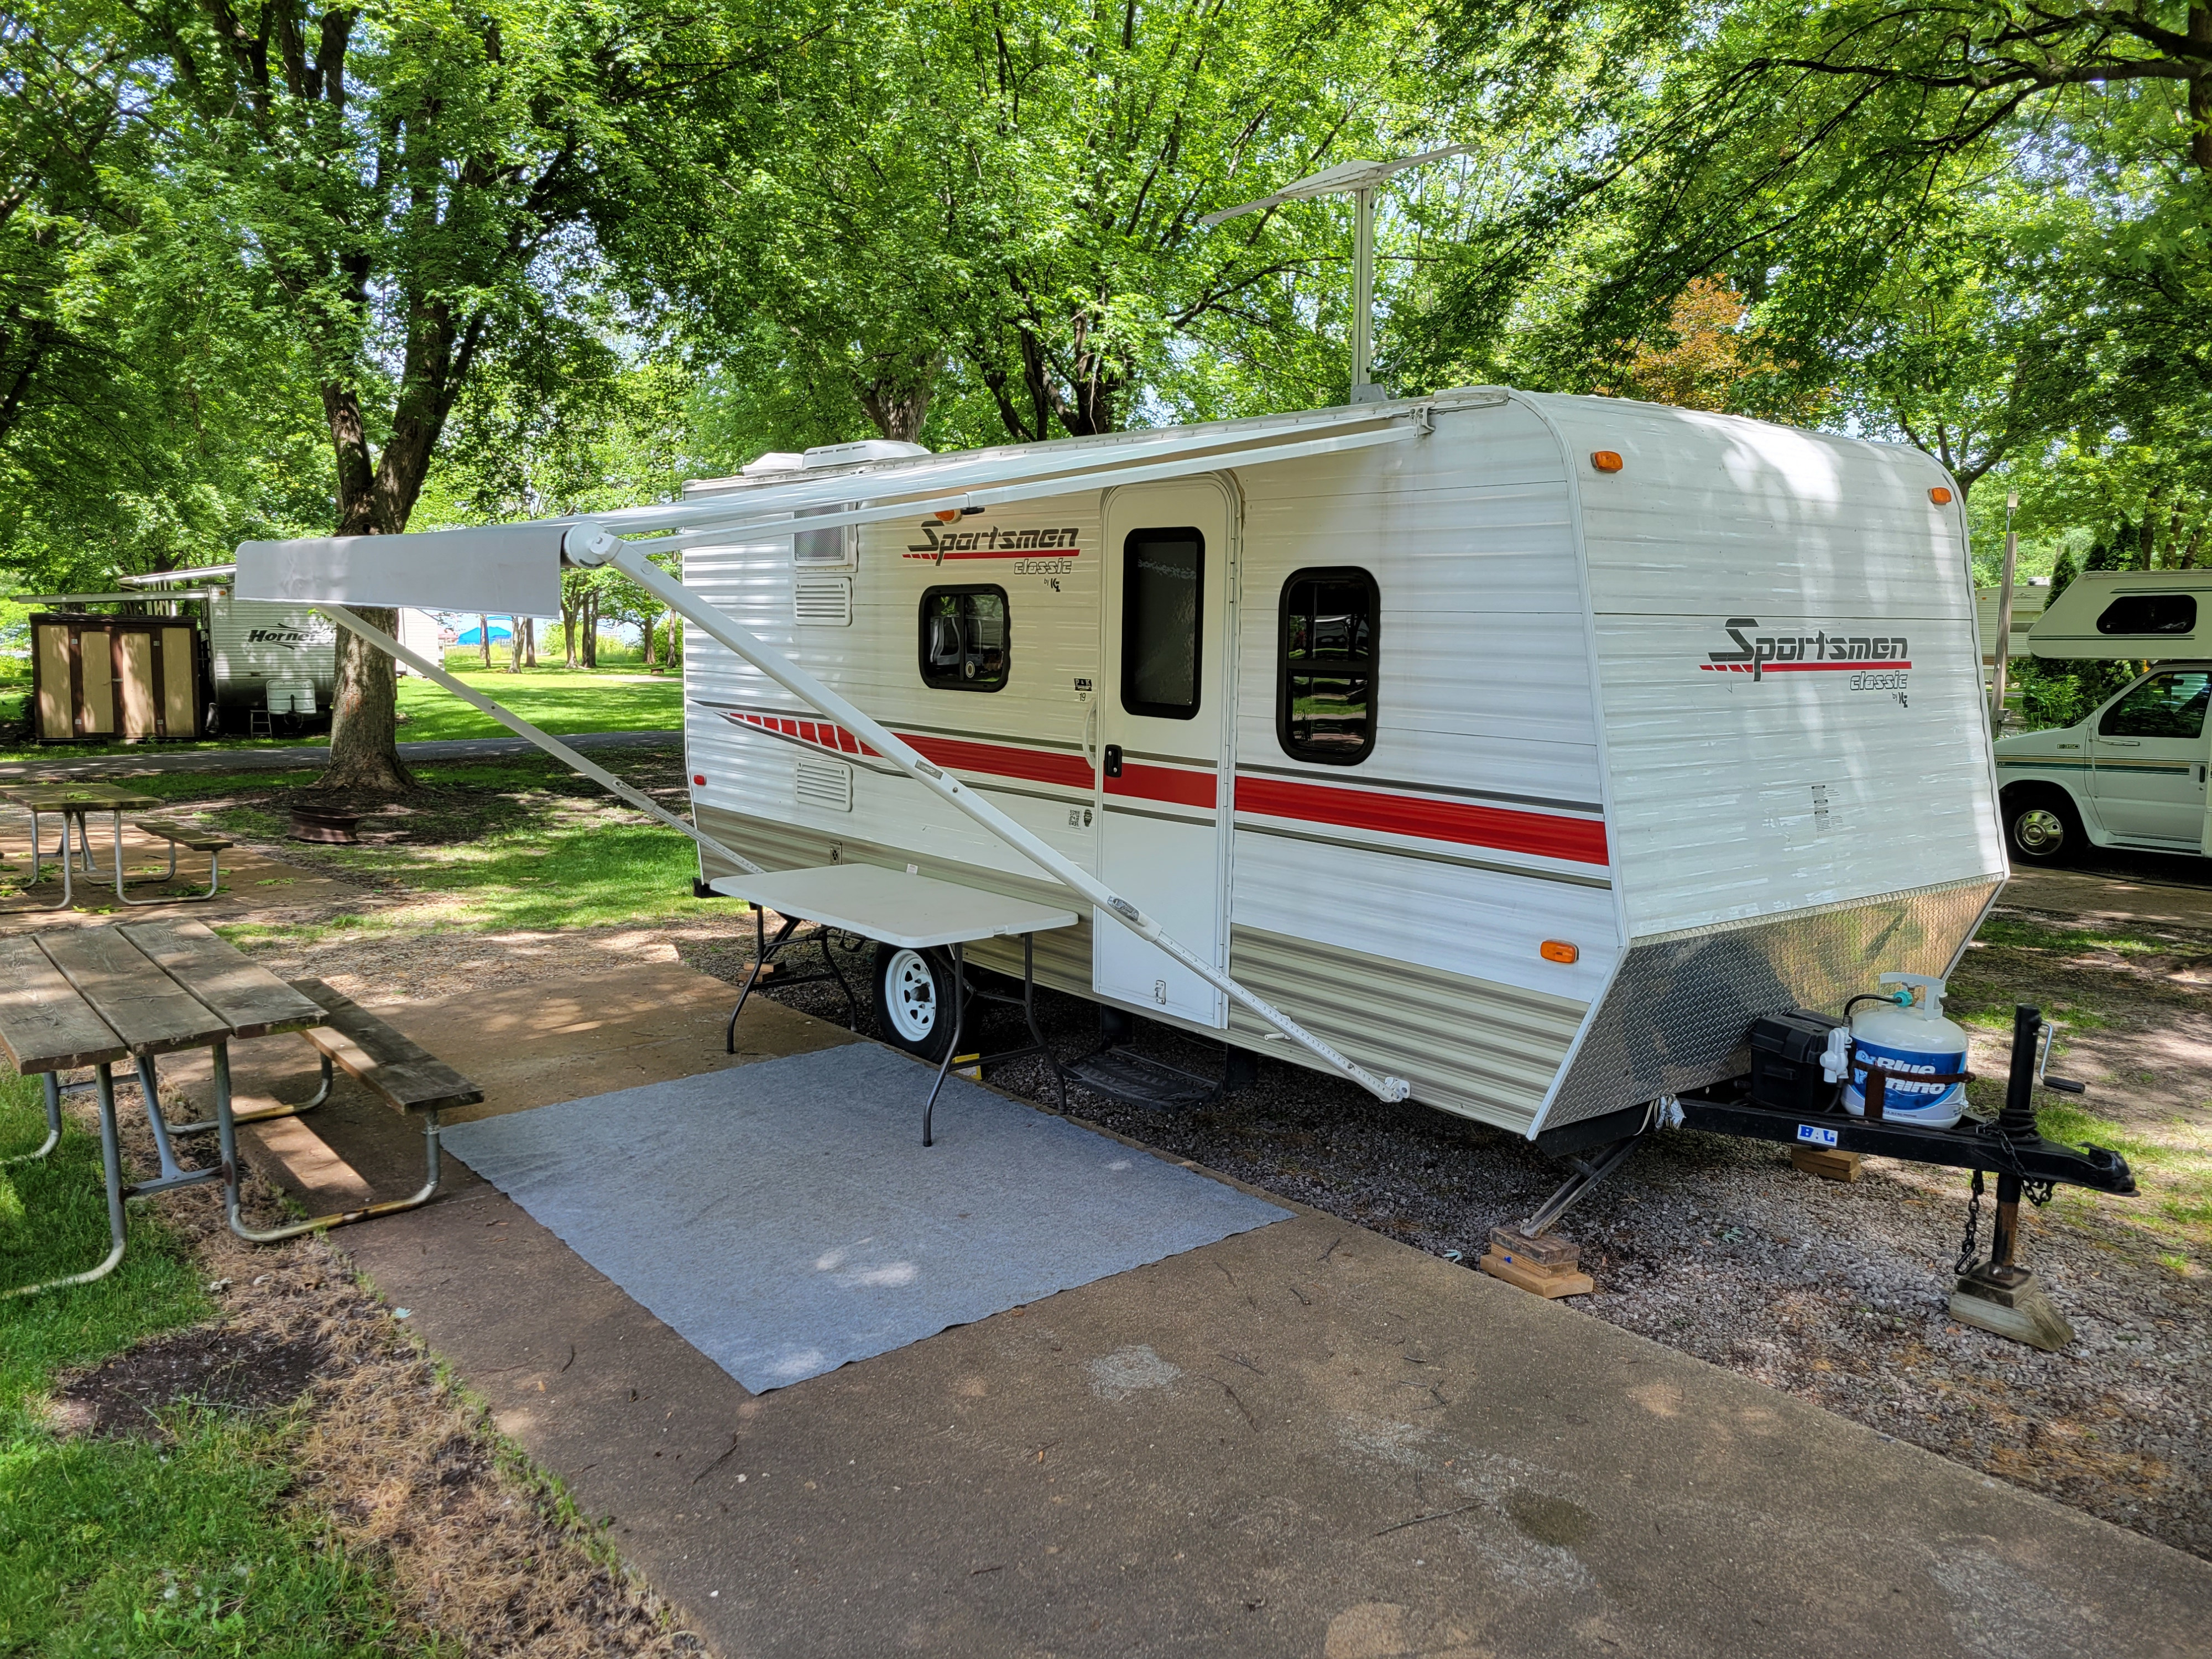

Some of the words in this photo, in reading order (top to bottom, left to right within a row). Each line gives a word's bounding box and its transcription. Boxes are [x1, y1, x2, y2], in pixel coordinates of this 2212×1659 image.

[907, 520, 1079, 566] Sportsmen
[1014, 558, 1072, 575] classic
[1708, 618, 1908, 681] Sportsmen
[1850, 670, 1908, 691] classic
[1079, 692, 1086, 702] 19
[1891, 692, 1897, 701] by
[1877, 1056, 1936, 1074] Blue
[1885, 1077, 1946, 1094] hino
